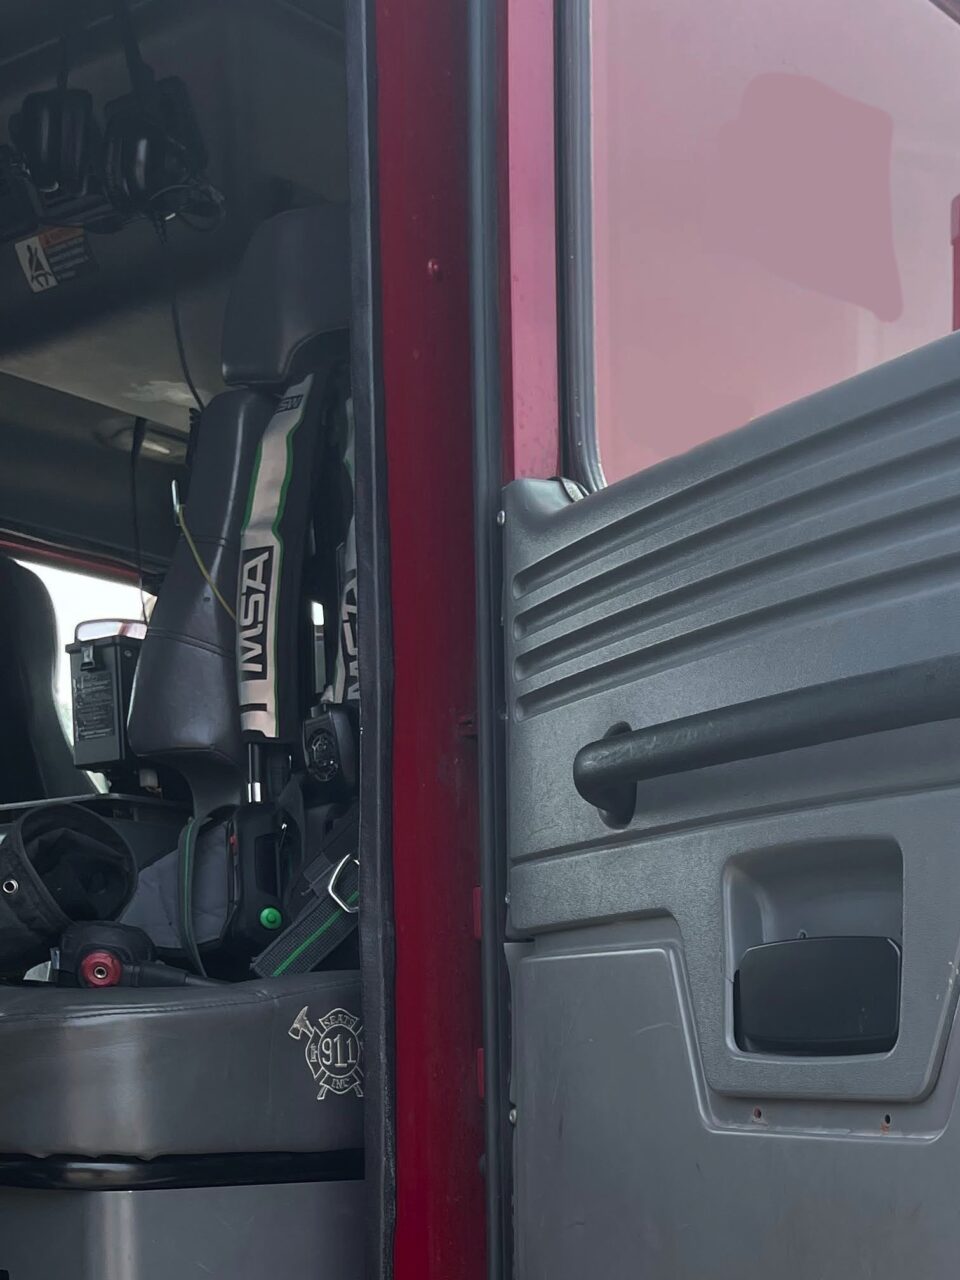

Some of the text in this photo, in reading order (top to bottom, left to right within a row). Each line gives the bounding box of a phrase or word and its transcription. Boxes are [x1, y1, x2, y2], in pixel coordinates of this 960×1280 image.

[240, 552, 270, 672] MSA
[323, 1014, 355, 1027] SEATS
[321, 1033, 356, 1067] 911
[331, 1078, 350, 1089] INC
